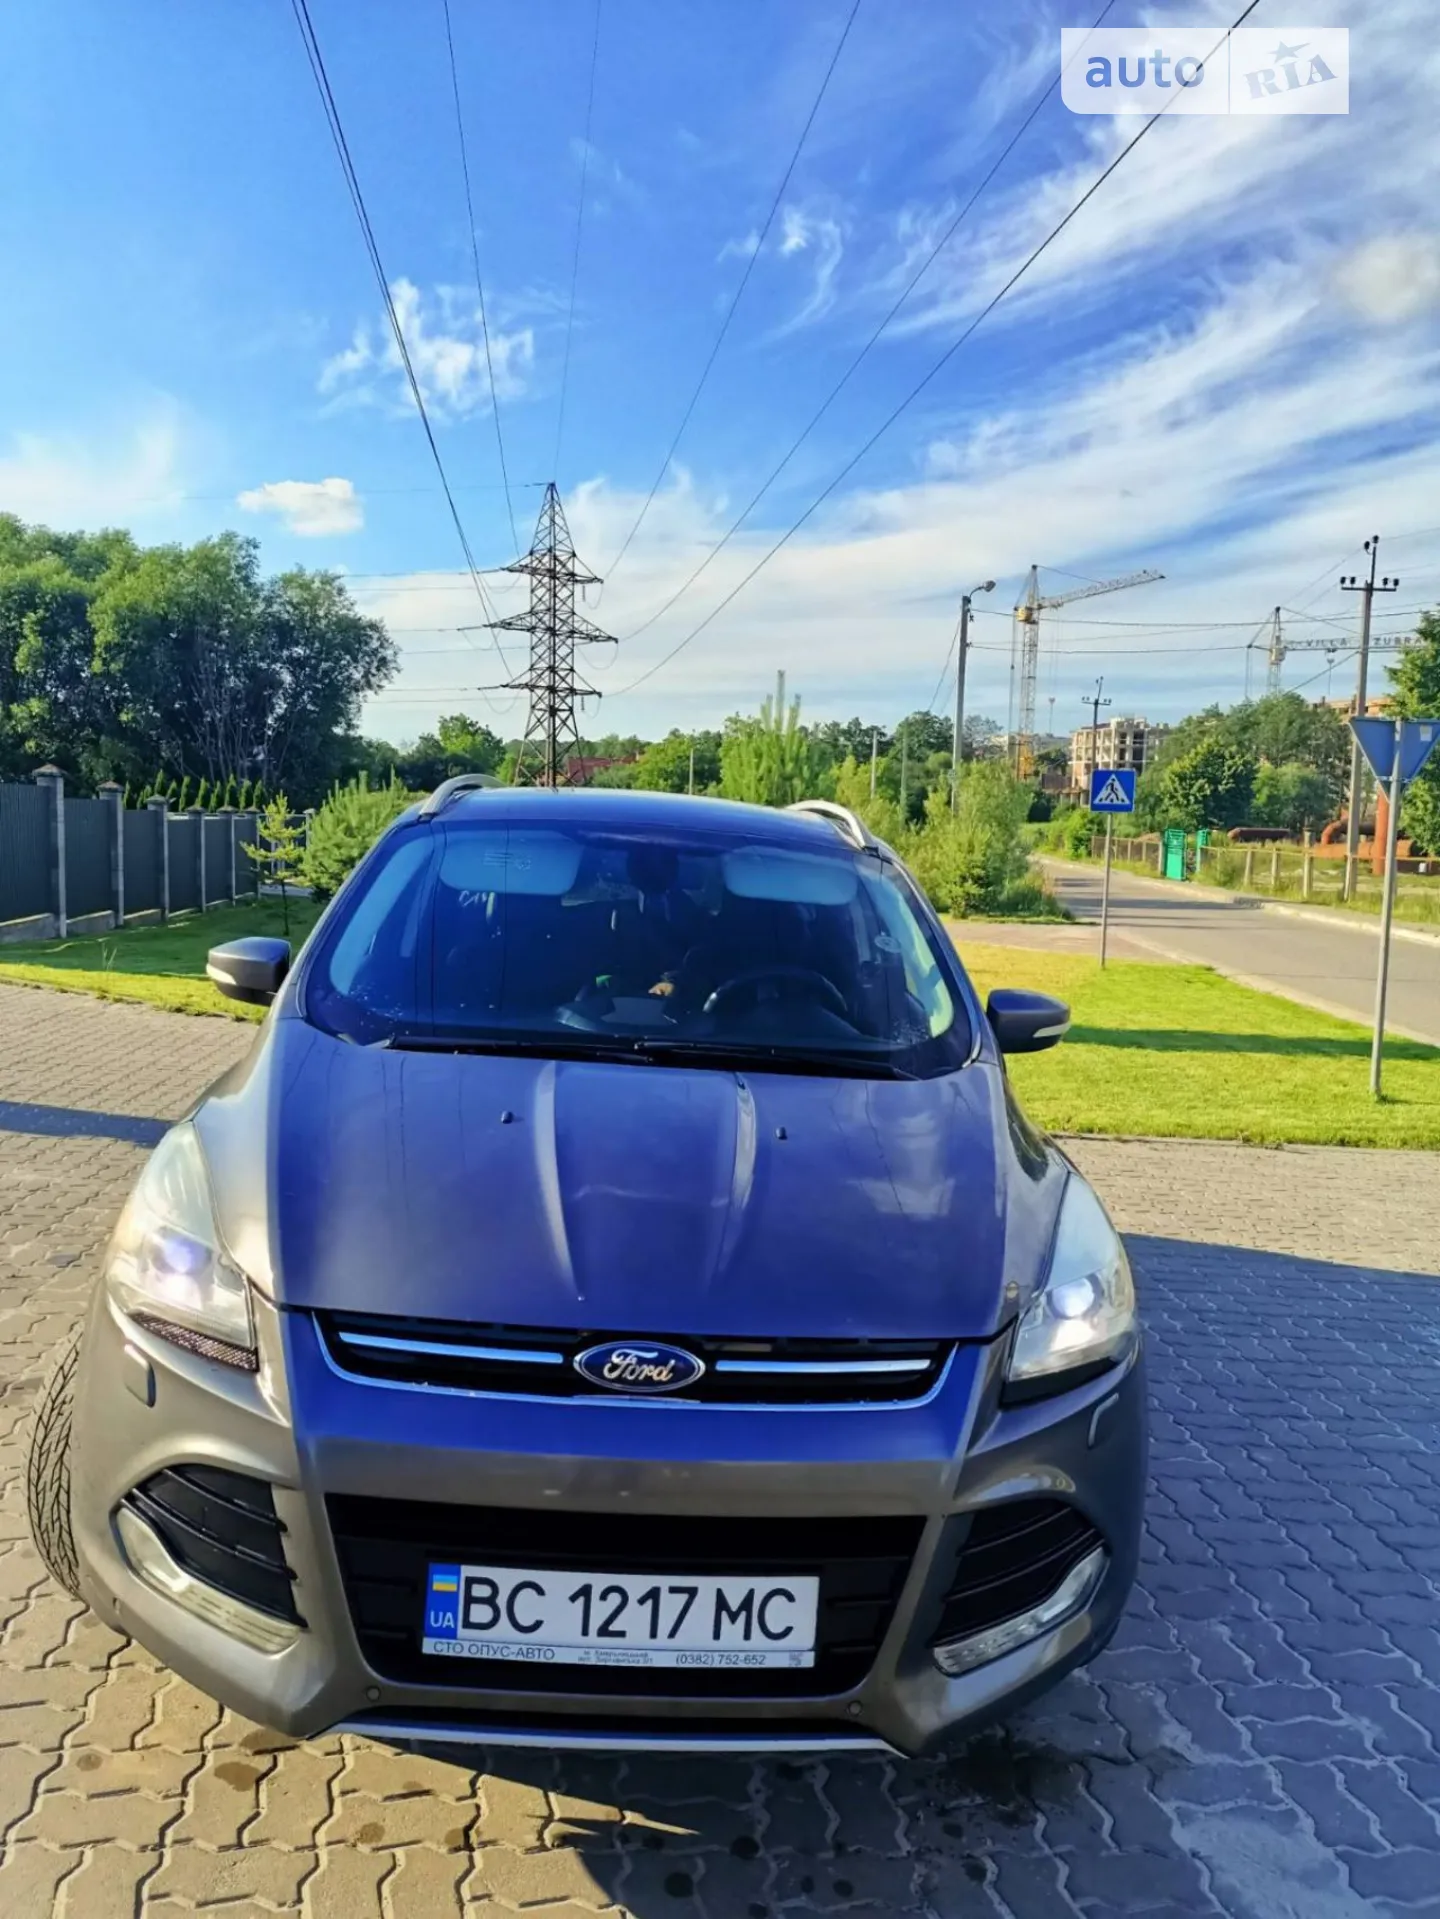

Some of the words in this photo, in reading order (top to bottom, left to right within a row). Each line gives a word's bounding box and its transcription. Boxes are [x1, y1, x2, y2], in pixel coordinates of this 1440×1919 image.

[1306, 638, 1348, 648] VILLA
[603, 1349, 676, 1381] Ford
[462, 1576, 546, 1634] BC
[568, 1583, 699, 1640] 1217
[712, 1587, 797, 1642] MC
[430, 1611, 455, 1628] UA
[433, 1641, 464, 1654] СТО
[467, 1643, 556, 1661] ОПУС-АВТО
[717, 1654, 767, 1666] 752-652
